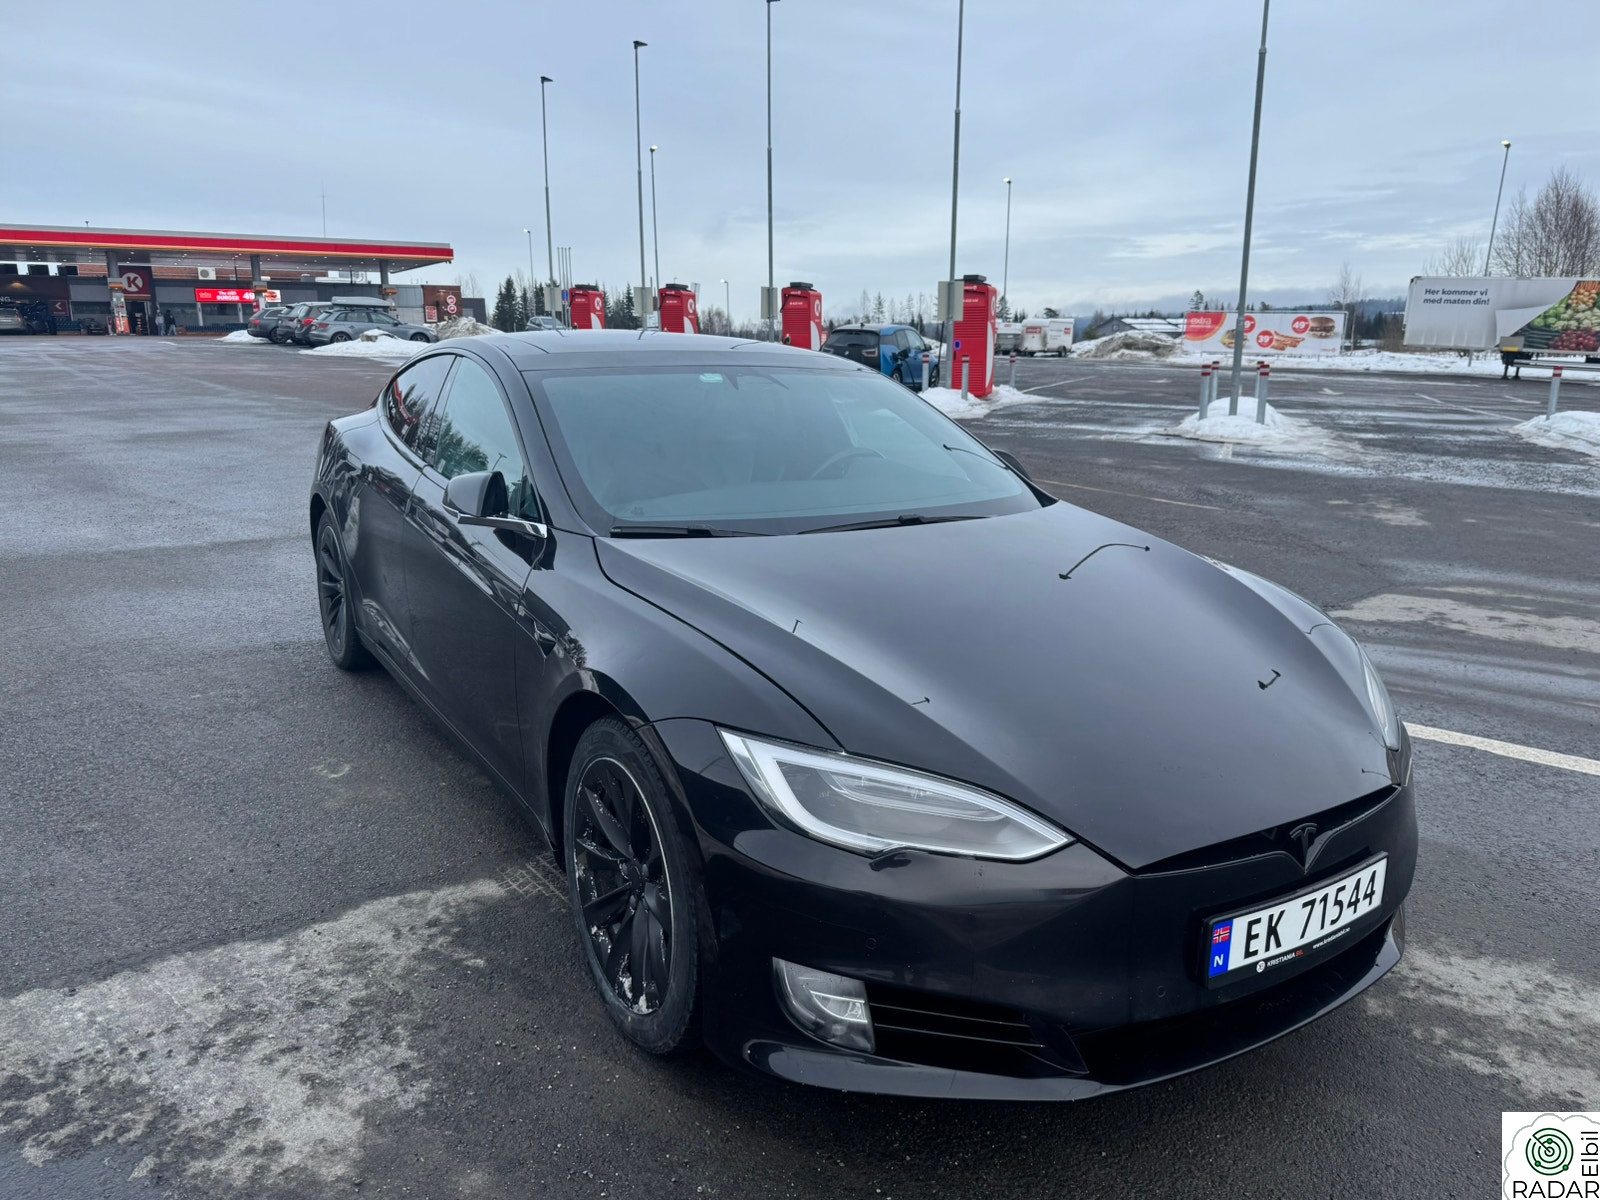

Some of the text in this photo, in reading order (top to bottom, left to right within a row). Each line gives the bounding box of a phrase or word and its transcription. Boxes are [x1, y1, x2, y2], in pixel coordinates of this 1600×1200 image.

[1424, 288, 1489, 296] Her kommer vi
[1423, 297, 1442, 305] med
[1472, 298, 1490, 306] din!
[1244, 870, 1377, 960] EK 71544
[1213, 953, 1224, 968] N
[1266, 952, 1296, 968] KRISTIANIA
